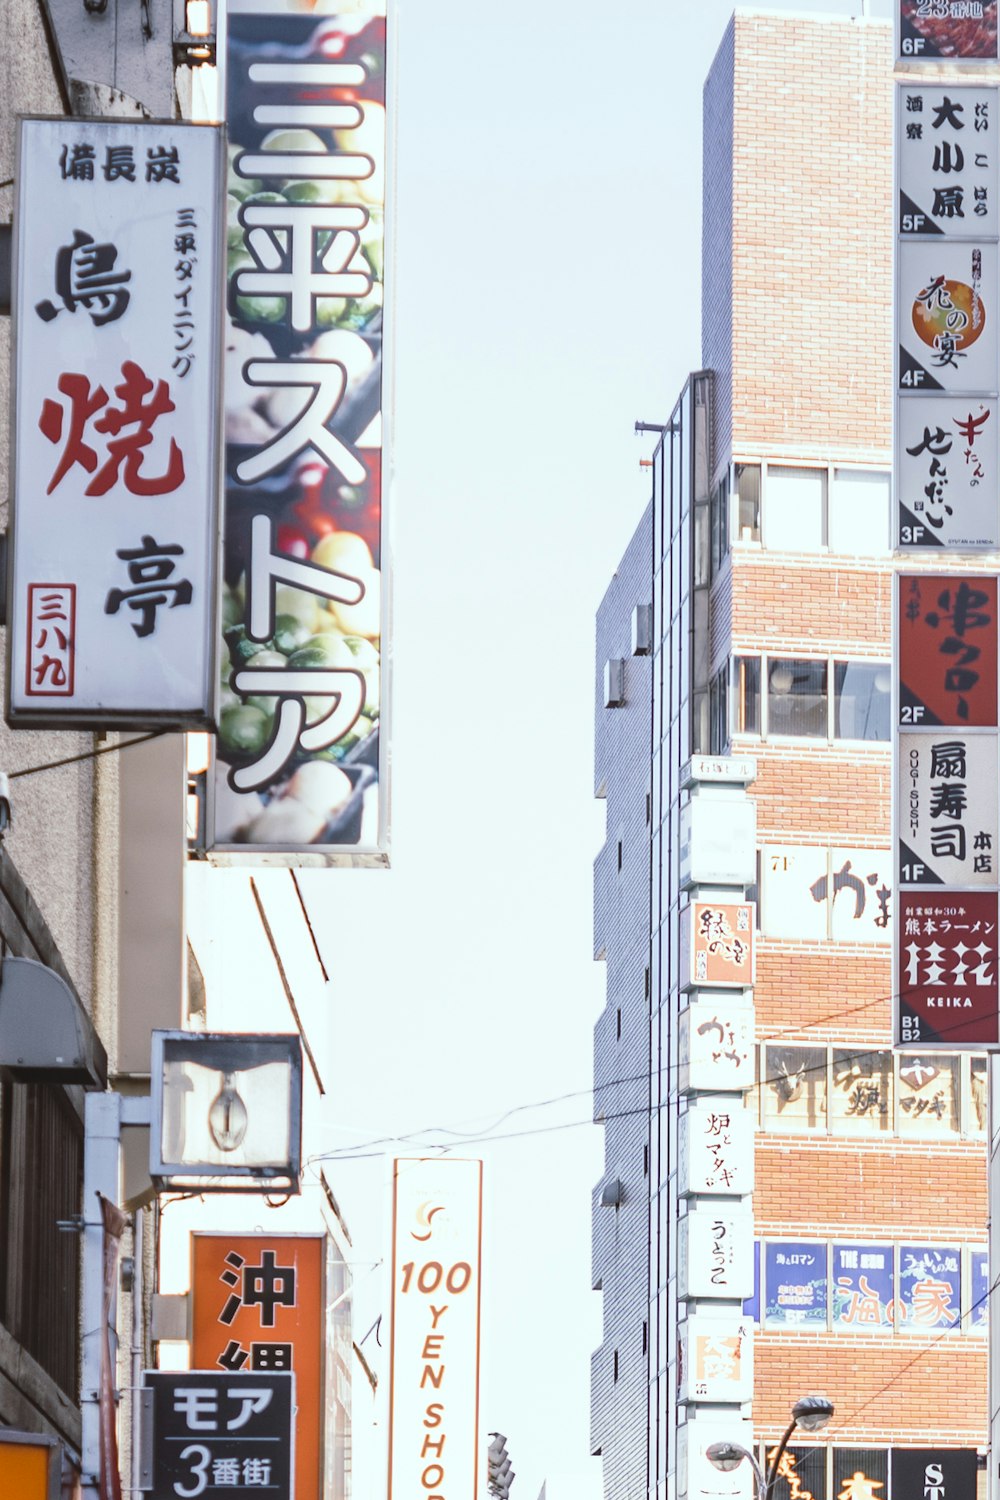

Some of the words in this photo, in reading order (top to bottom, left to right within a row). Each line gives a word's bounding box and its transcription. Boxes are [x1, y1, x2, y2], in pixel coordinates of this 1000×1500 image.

[902, 38, 925, 54] 6F
[59, 143, 181, 184] 備長炭
[932, 96, 965, 218] 大小原
[903, 216, 925, 231] 5F
[172, 207, 198, 378] 三平ダイニング
[915, 275, 969, 369] 花の宴
[901, 371, 925, 386] 4F
[230, 60, 376, 795] 三平ストア
[906, 427, 953, 528] せんだい
[901, 527, 925, 543] 3F
[34, 592, 68, 687] 三八九
[901, 706, 925, 723] 2F
[930, 741, 967, 862] 扇寿司
[902, 864, 925, 881] 1F
[973, 831, 993, 873] 本店
[905, 918, 995, 936] 熊本ラーメン
[902, 1016, 920, 1028] B1
[927, 997, 973, 1007] KEIKA
[902, 1030, 921, 1042] B2
[402, 1261, 471, 1294] 100
[420, 1305, 448, 1389] YEN
[174, 1388, 273, 1430] モア
[173, 1445, 271, 1498] 3番街
